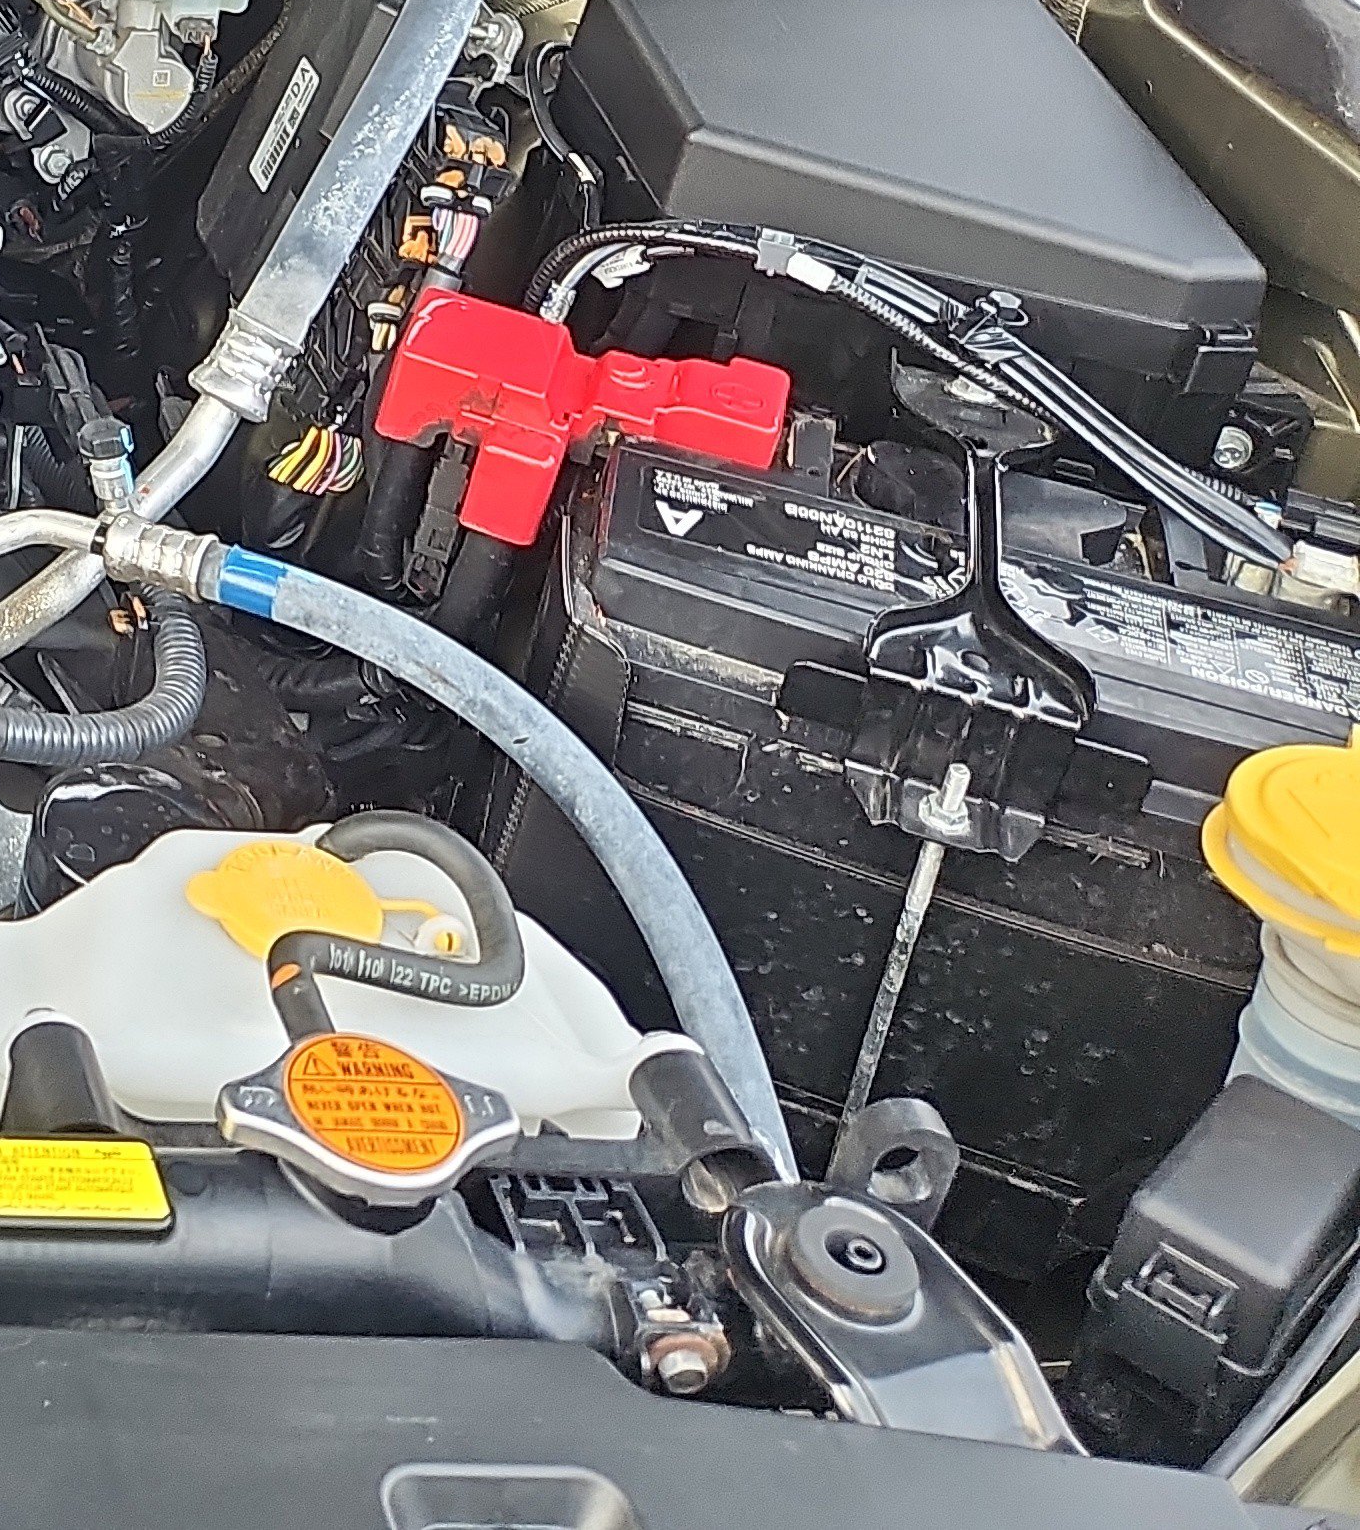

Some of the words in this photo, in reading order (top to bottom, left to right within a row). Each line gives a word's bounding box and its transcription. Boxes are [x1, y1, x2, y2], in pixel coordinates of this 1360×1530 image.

[746, 543, 784, 562] AMPS
[807, 549, 860, 572] AMPS
[860, 542, 894, 562] LN2
[785, 554, 855, 582] CRANKING
[419, 971, 453, 995] TPC
[337, 1060, 415, 1080] WARNING
